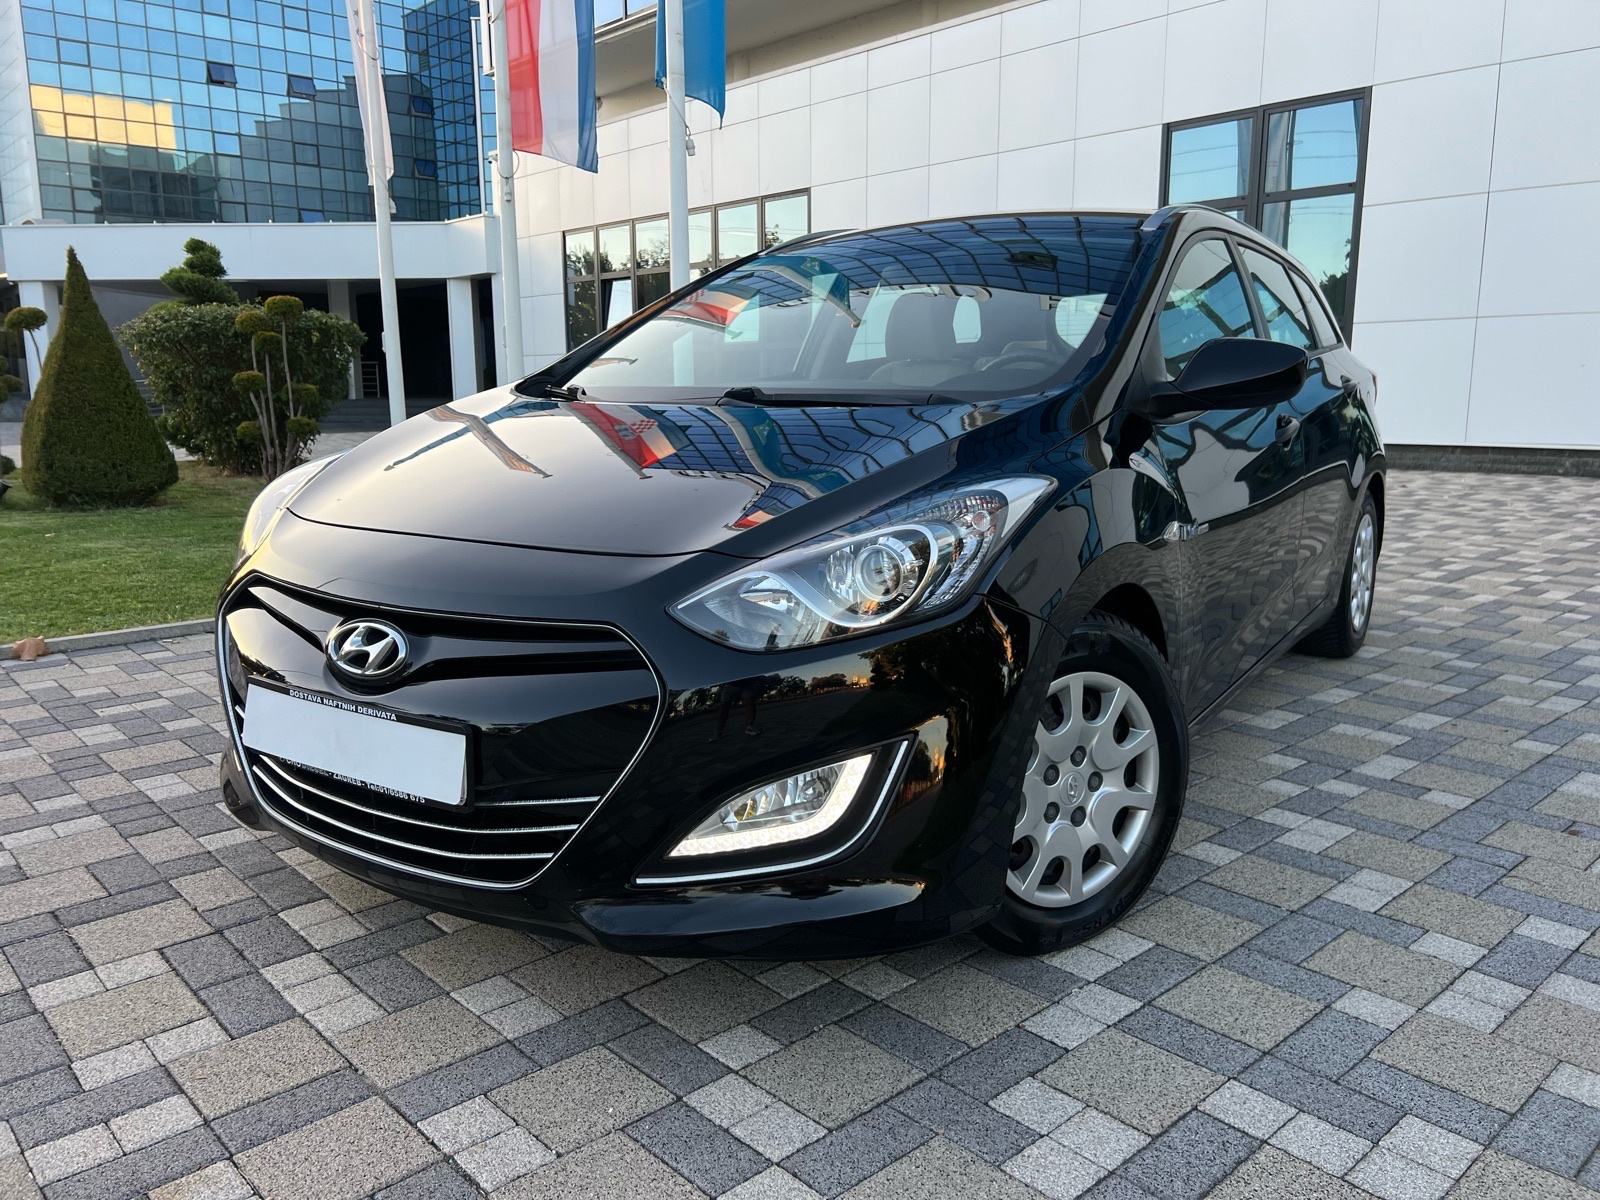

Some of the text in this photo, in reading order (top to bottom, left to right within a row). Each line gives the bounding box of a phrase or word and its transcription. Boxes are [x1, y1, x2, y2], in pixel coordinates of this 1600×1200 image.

[289, 689, 397, 721] DOSTAVA NAFTNIH DERIVATA
